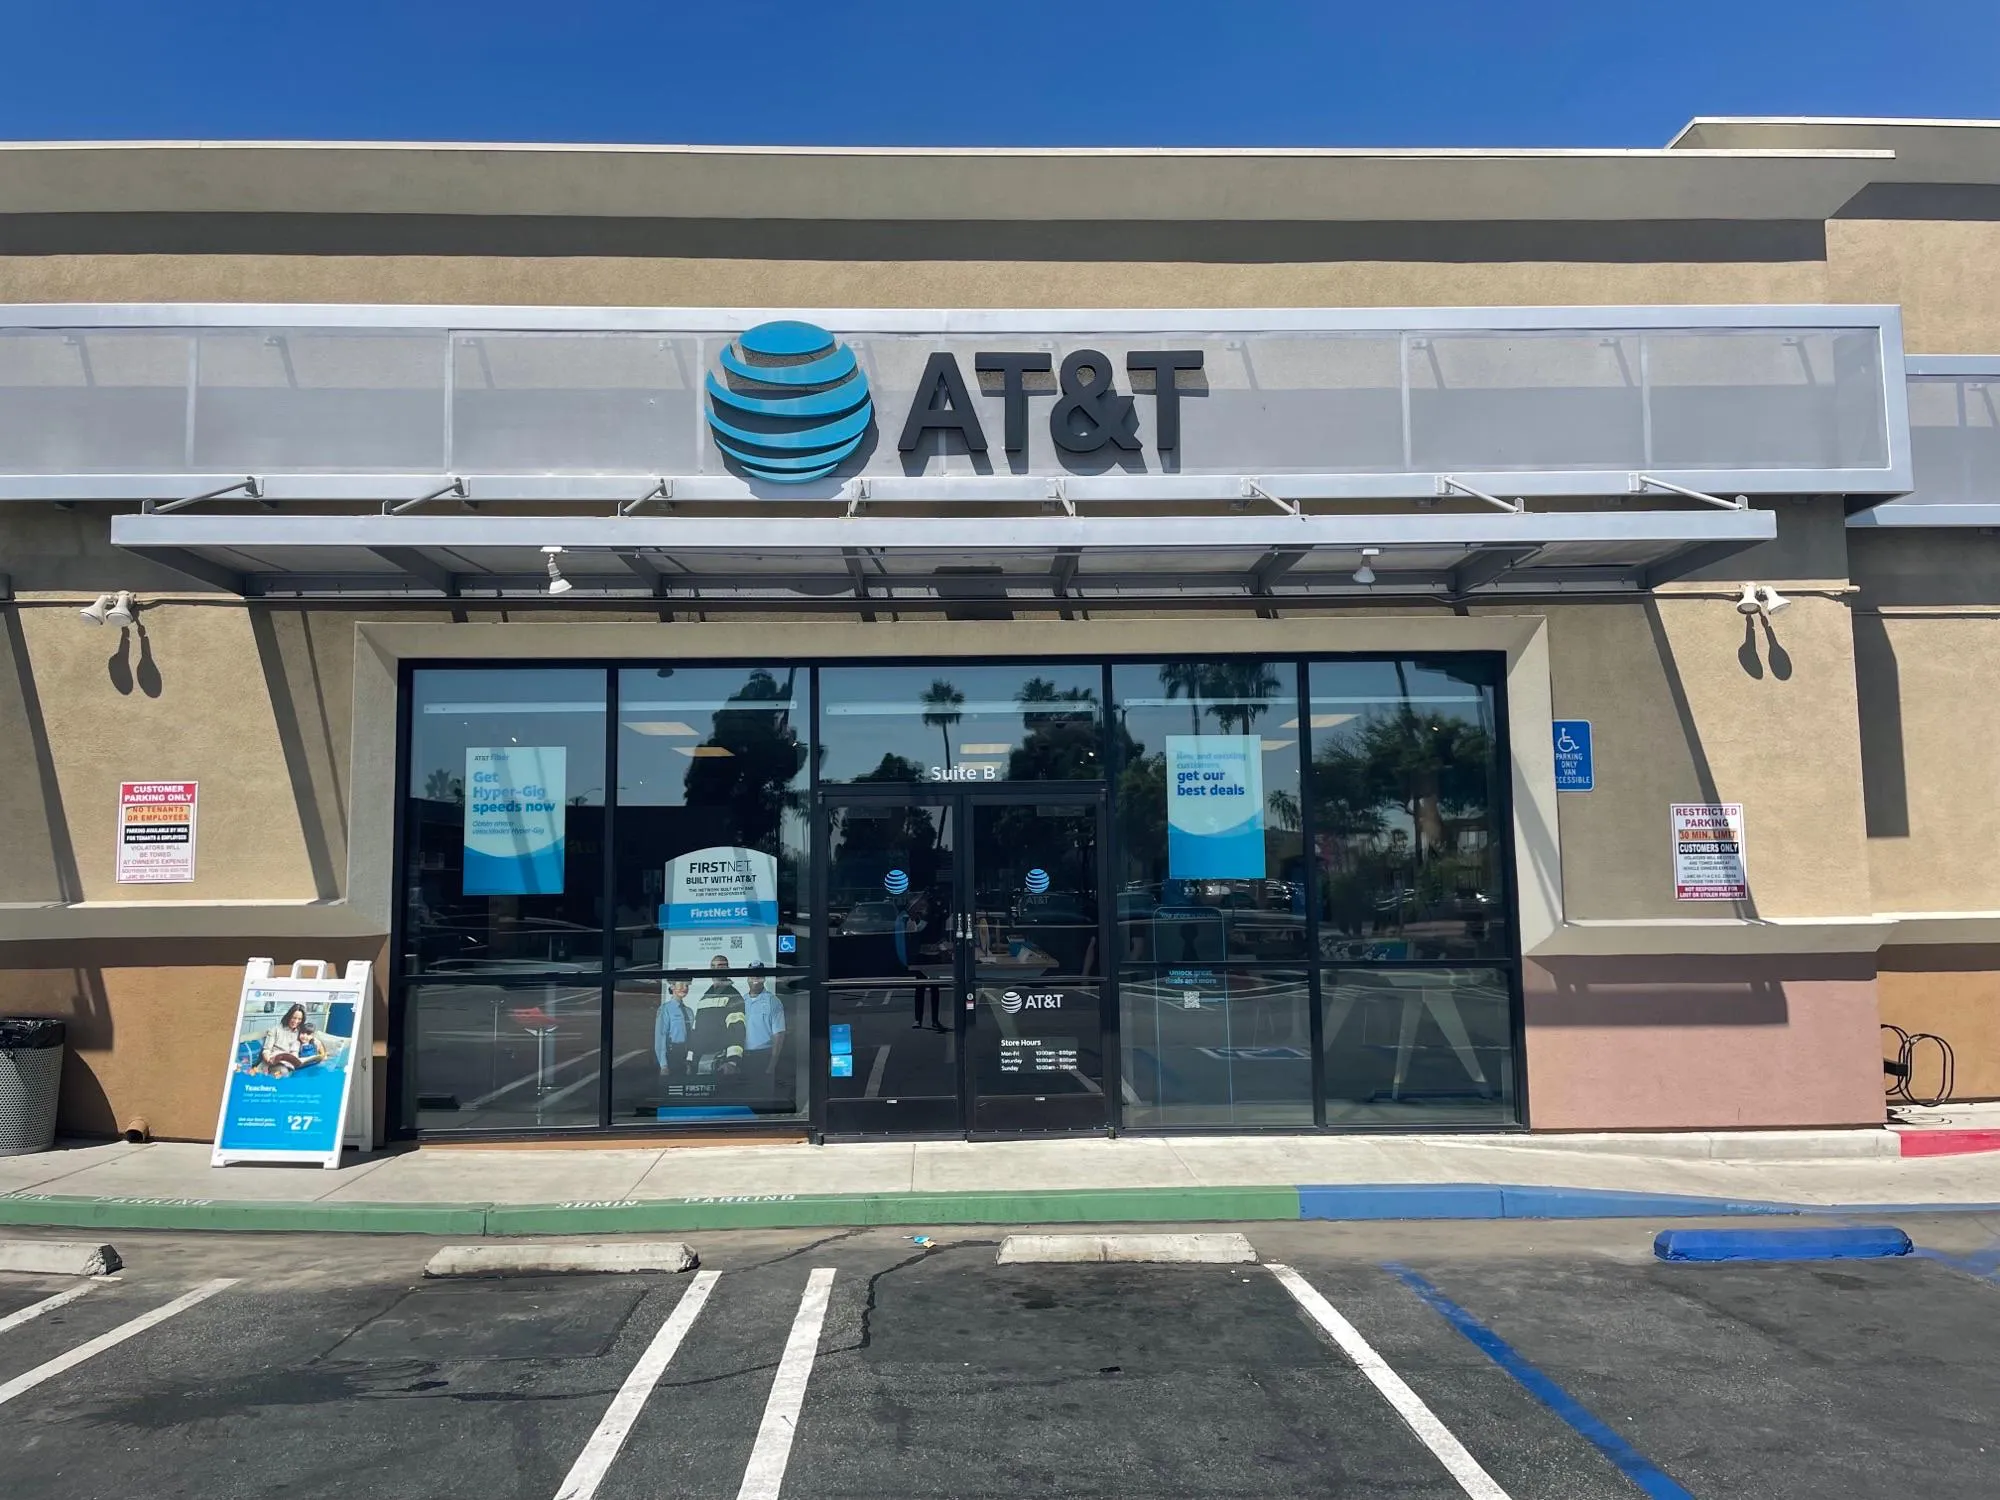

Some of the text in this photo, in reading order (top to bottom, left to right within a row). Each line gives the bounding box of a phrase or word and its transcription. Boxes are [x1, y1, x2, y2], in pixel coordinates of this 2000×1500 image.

[898, 349, 1204, 452] AT&T
[473, 771, 499, 783] Get
[931, 766, 996, 781] Suite B
[1177, 771, 1226, 783] get our
[472, 785, 546, 800] Hyper-Gig
[1177, 784, 1245, 796] best deals
[124, 794, 166, 802] PARKING
[472, 800, 556, 816] speeds now
[1676, 808, 1737, 816] RESTRICTED
[1685, 819, 1729, 827] PARKING
[1680, 831, 1690, 839] 30
[1713, 830, 1736, 839] LIMIT
[1680, 844, 1738, 853] CUSTOMERS ONLY
[686, 875, 757, 885] BUILT WITH AT&T
[1026, 896, 1049, 904] AT&T
[690, 907, 748, 918] FirstNet 5G
[1024, 994, 1064, 1009] AT&T
[685, 1084, 716, 1092] FIRSTNET
[94, 1196, 213, 1206] PARKING
[684, 1194, 796, 1204] PARKING
